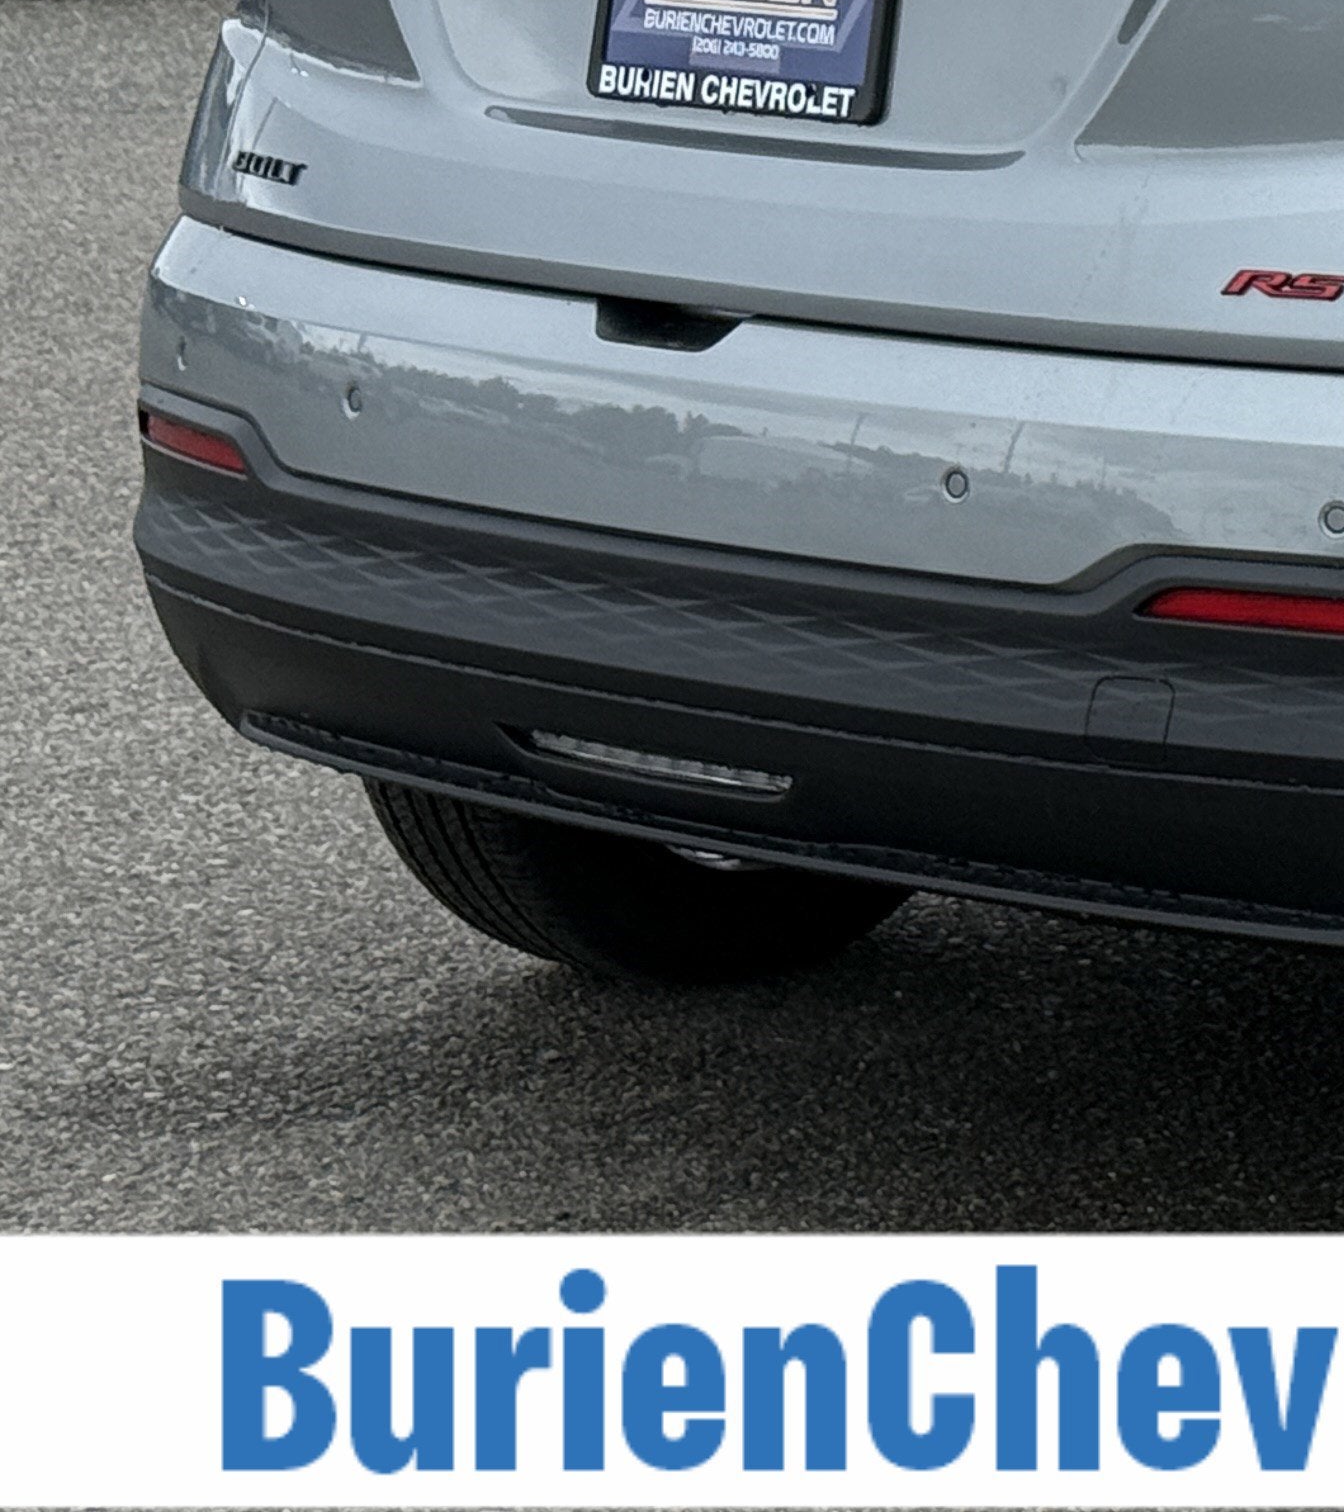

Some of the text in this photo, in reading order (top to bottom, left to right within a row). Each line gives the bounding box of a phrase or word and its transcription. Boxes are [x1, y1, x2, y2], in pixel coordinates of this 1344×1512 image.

[643, 8, 836, 46] BURIENCHEVROLET.COM
[599, 63, 856, 118] BURIEN CHEVROLET
